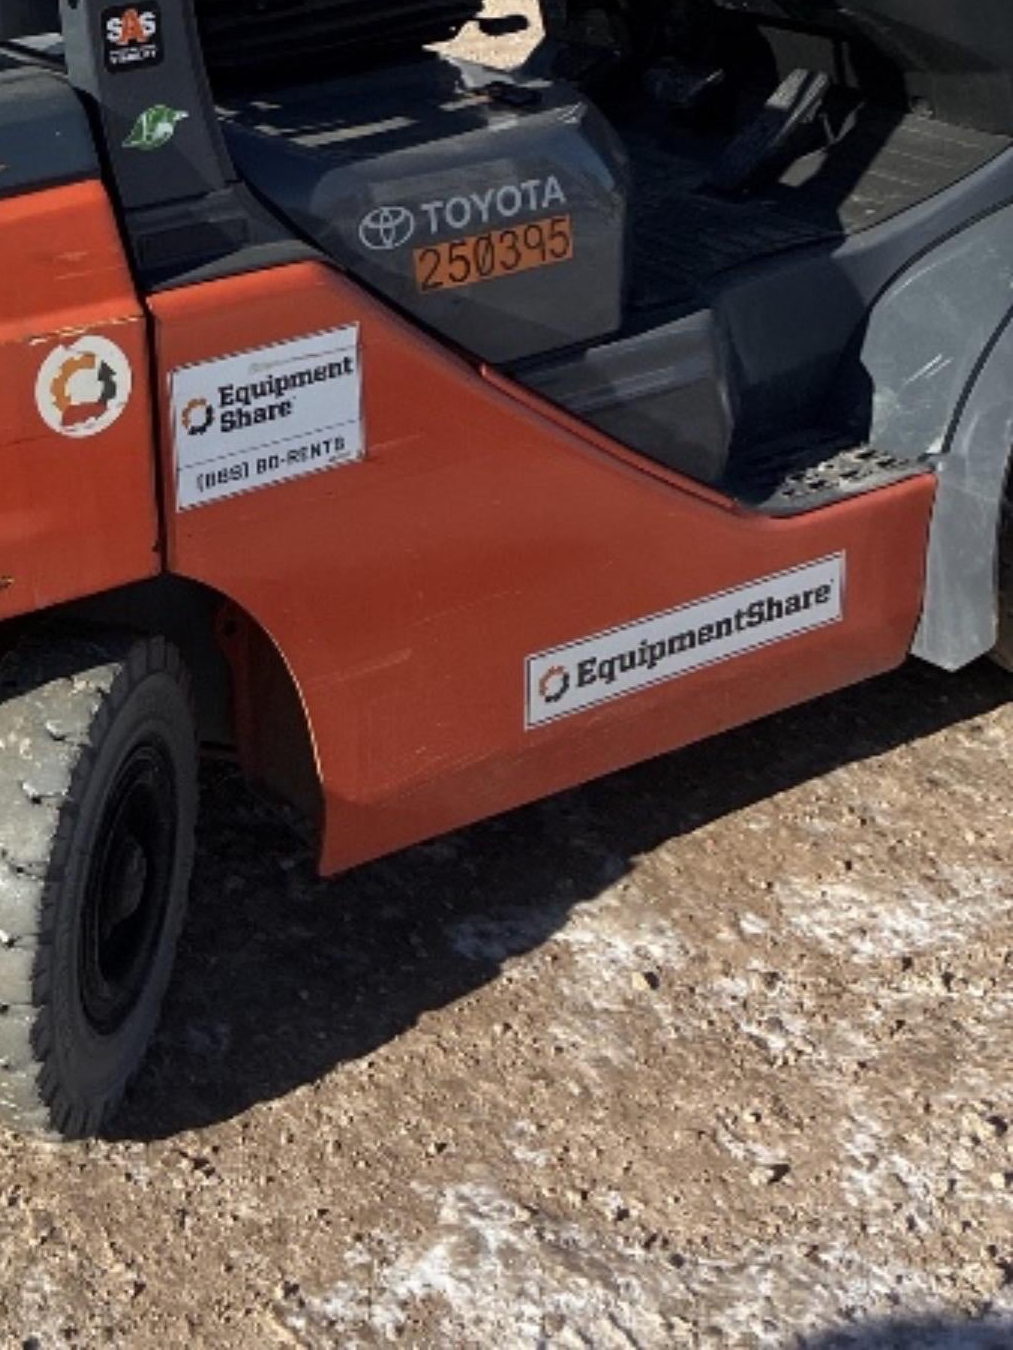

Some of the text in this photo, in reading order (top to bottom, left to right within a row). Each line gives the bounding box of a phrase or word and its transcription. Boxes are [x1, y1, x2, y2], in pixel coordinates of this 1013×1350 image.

[106, 8, 157, 45] SAS
[421, 175, 567, 234] TOYOTA
[419, 218, 570, 291] 250395
[218, 356, 354, 408] Equipment
[219, 400, 293, 434] Share
[575, 581, 832, 689] EquipmentShare
